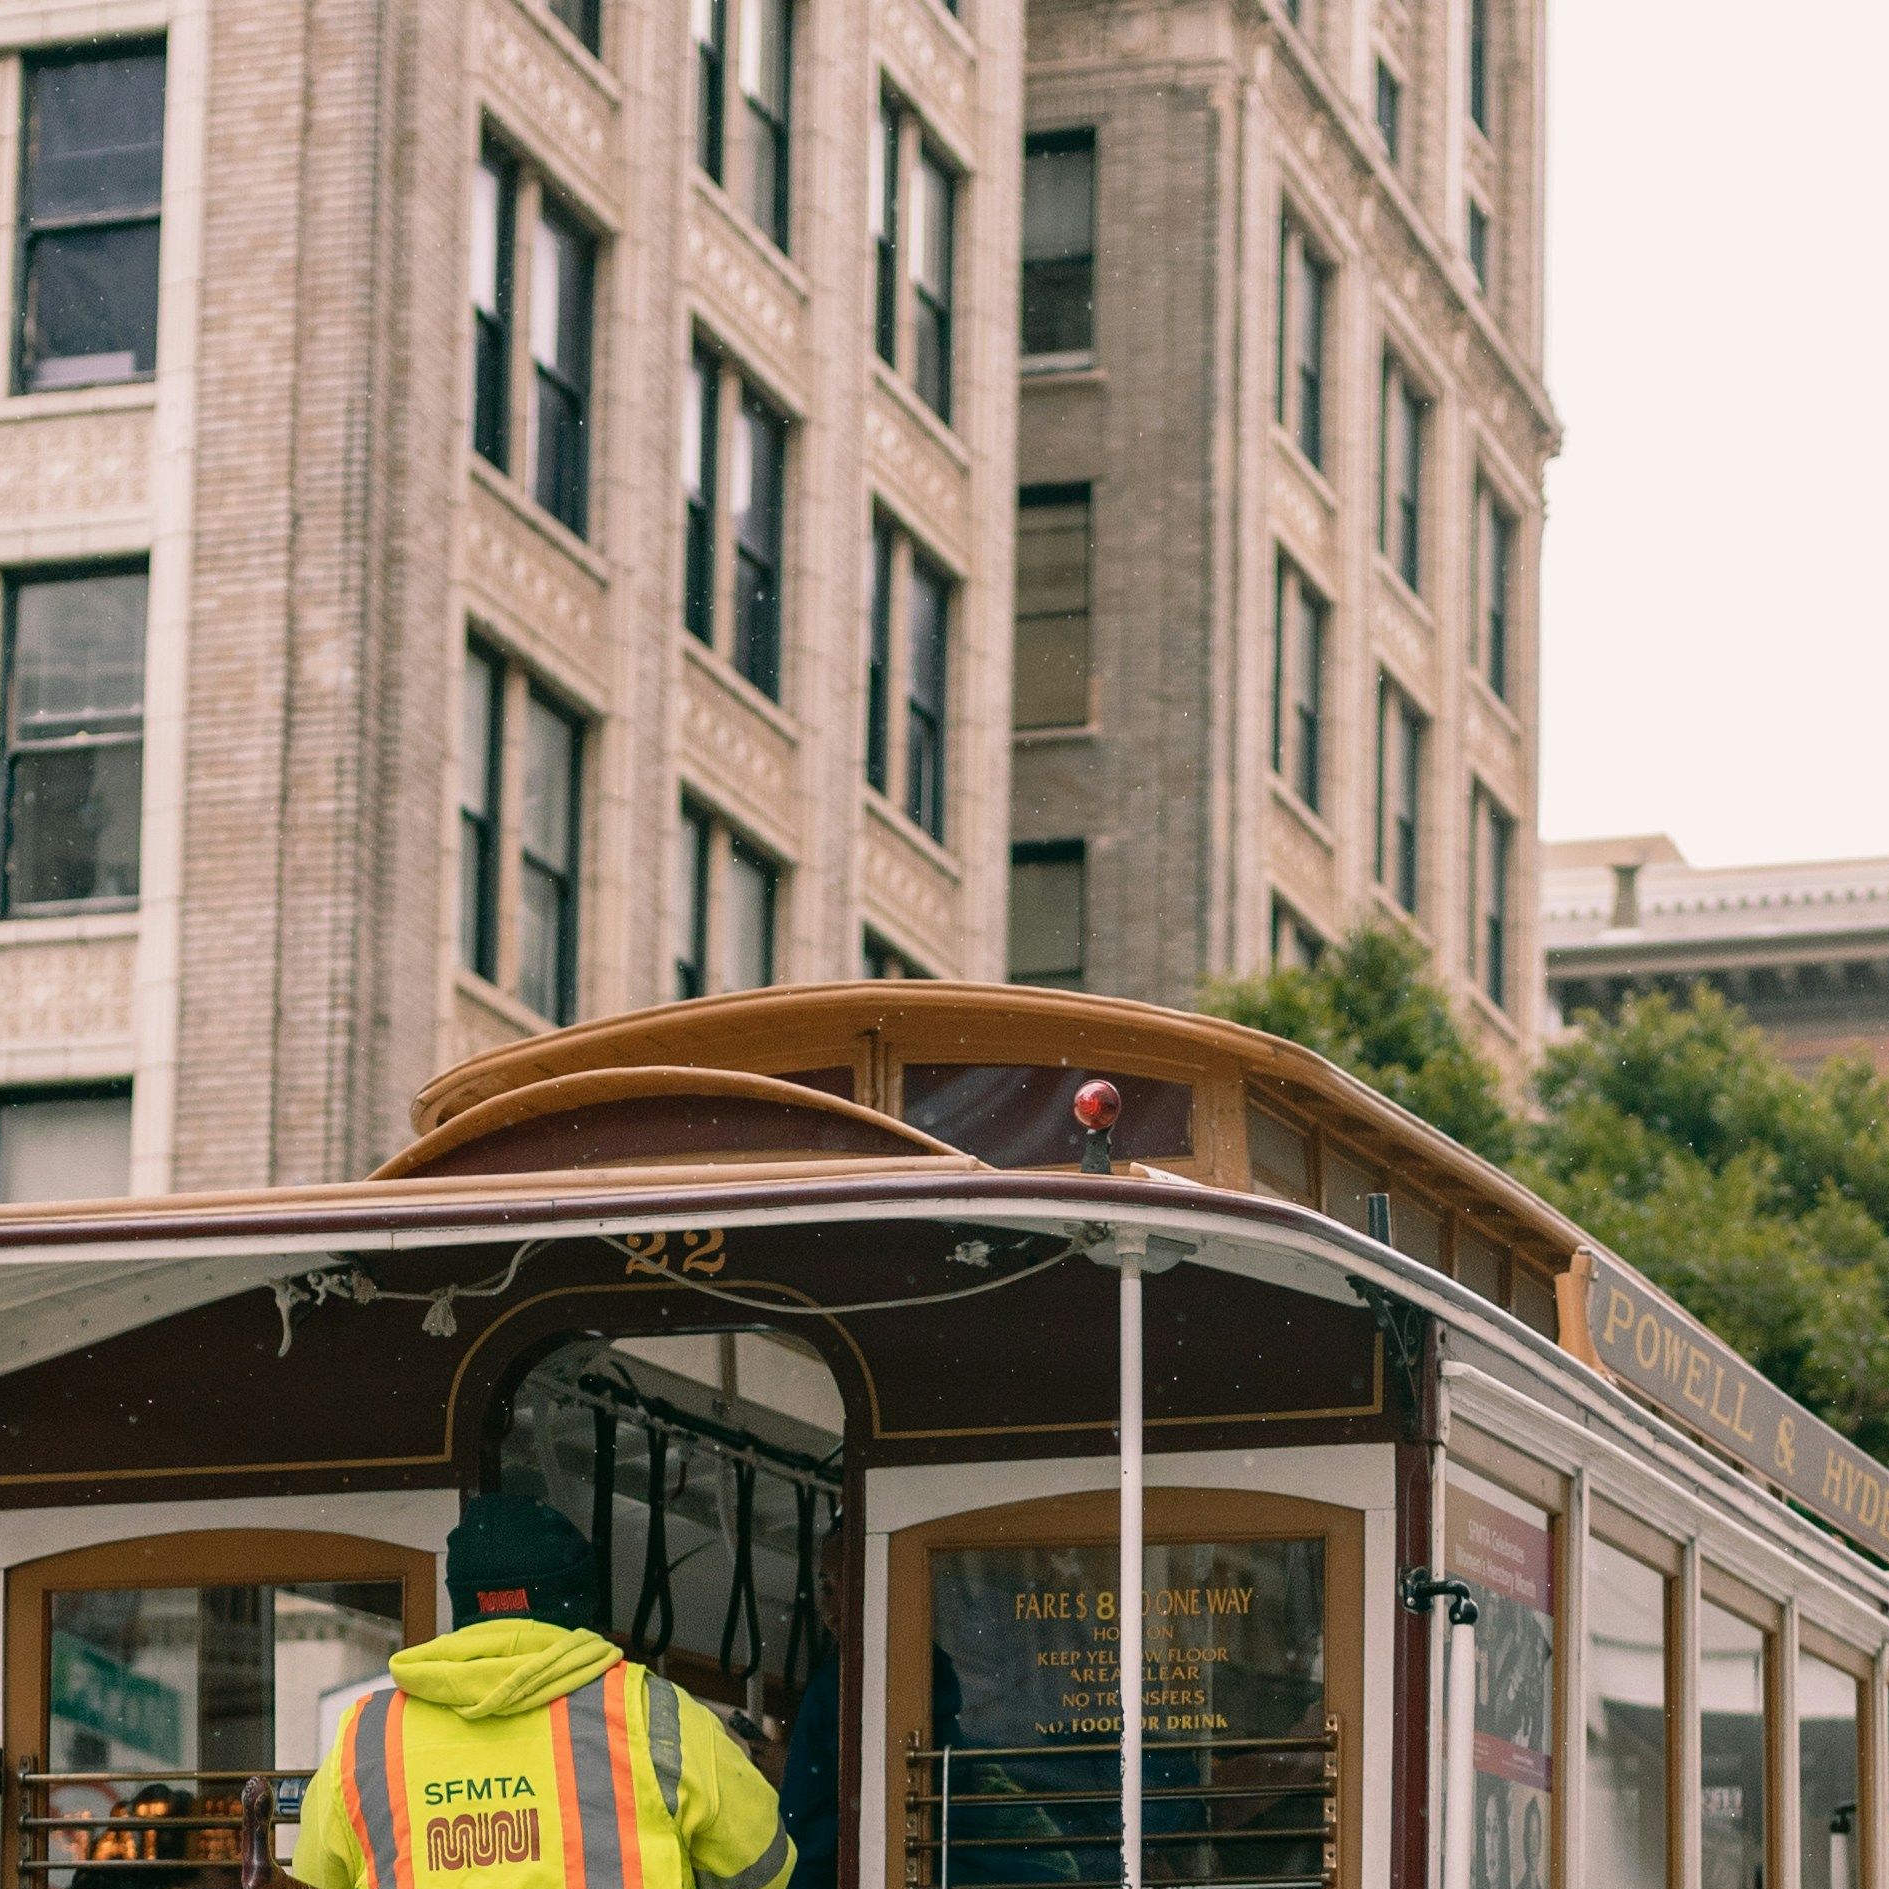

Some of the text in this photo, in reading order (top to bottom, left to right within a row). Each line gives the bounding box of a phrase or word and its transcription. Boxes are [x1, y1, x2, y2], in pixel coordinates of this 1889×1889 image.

[624, 1228, 727, 1275] 22
[1602, 1285, 1754, 1442] POWELL
[1774, 1416, 1797, 1476] &
[1015, 1592, 1070, 1620] FARE
[1156, 1589, 1201, 1616] ONE
[1206, 1587, 1253, 1615] WAY
[1146, 1624, 1174, 1640] ON
[1037, 1648, 1229, 1667] KEEP YELW FLOOR
[1063, 1689, 1205, 1708] NO TRNSFERS
[1167, 1712, 1229, 1729] DRINK
[425, 1776, 536, 1805] SFMTA
